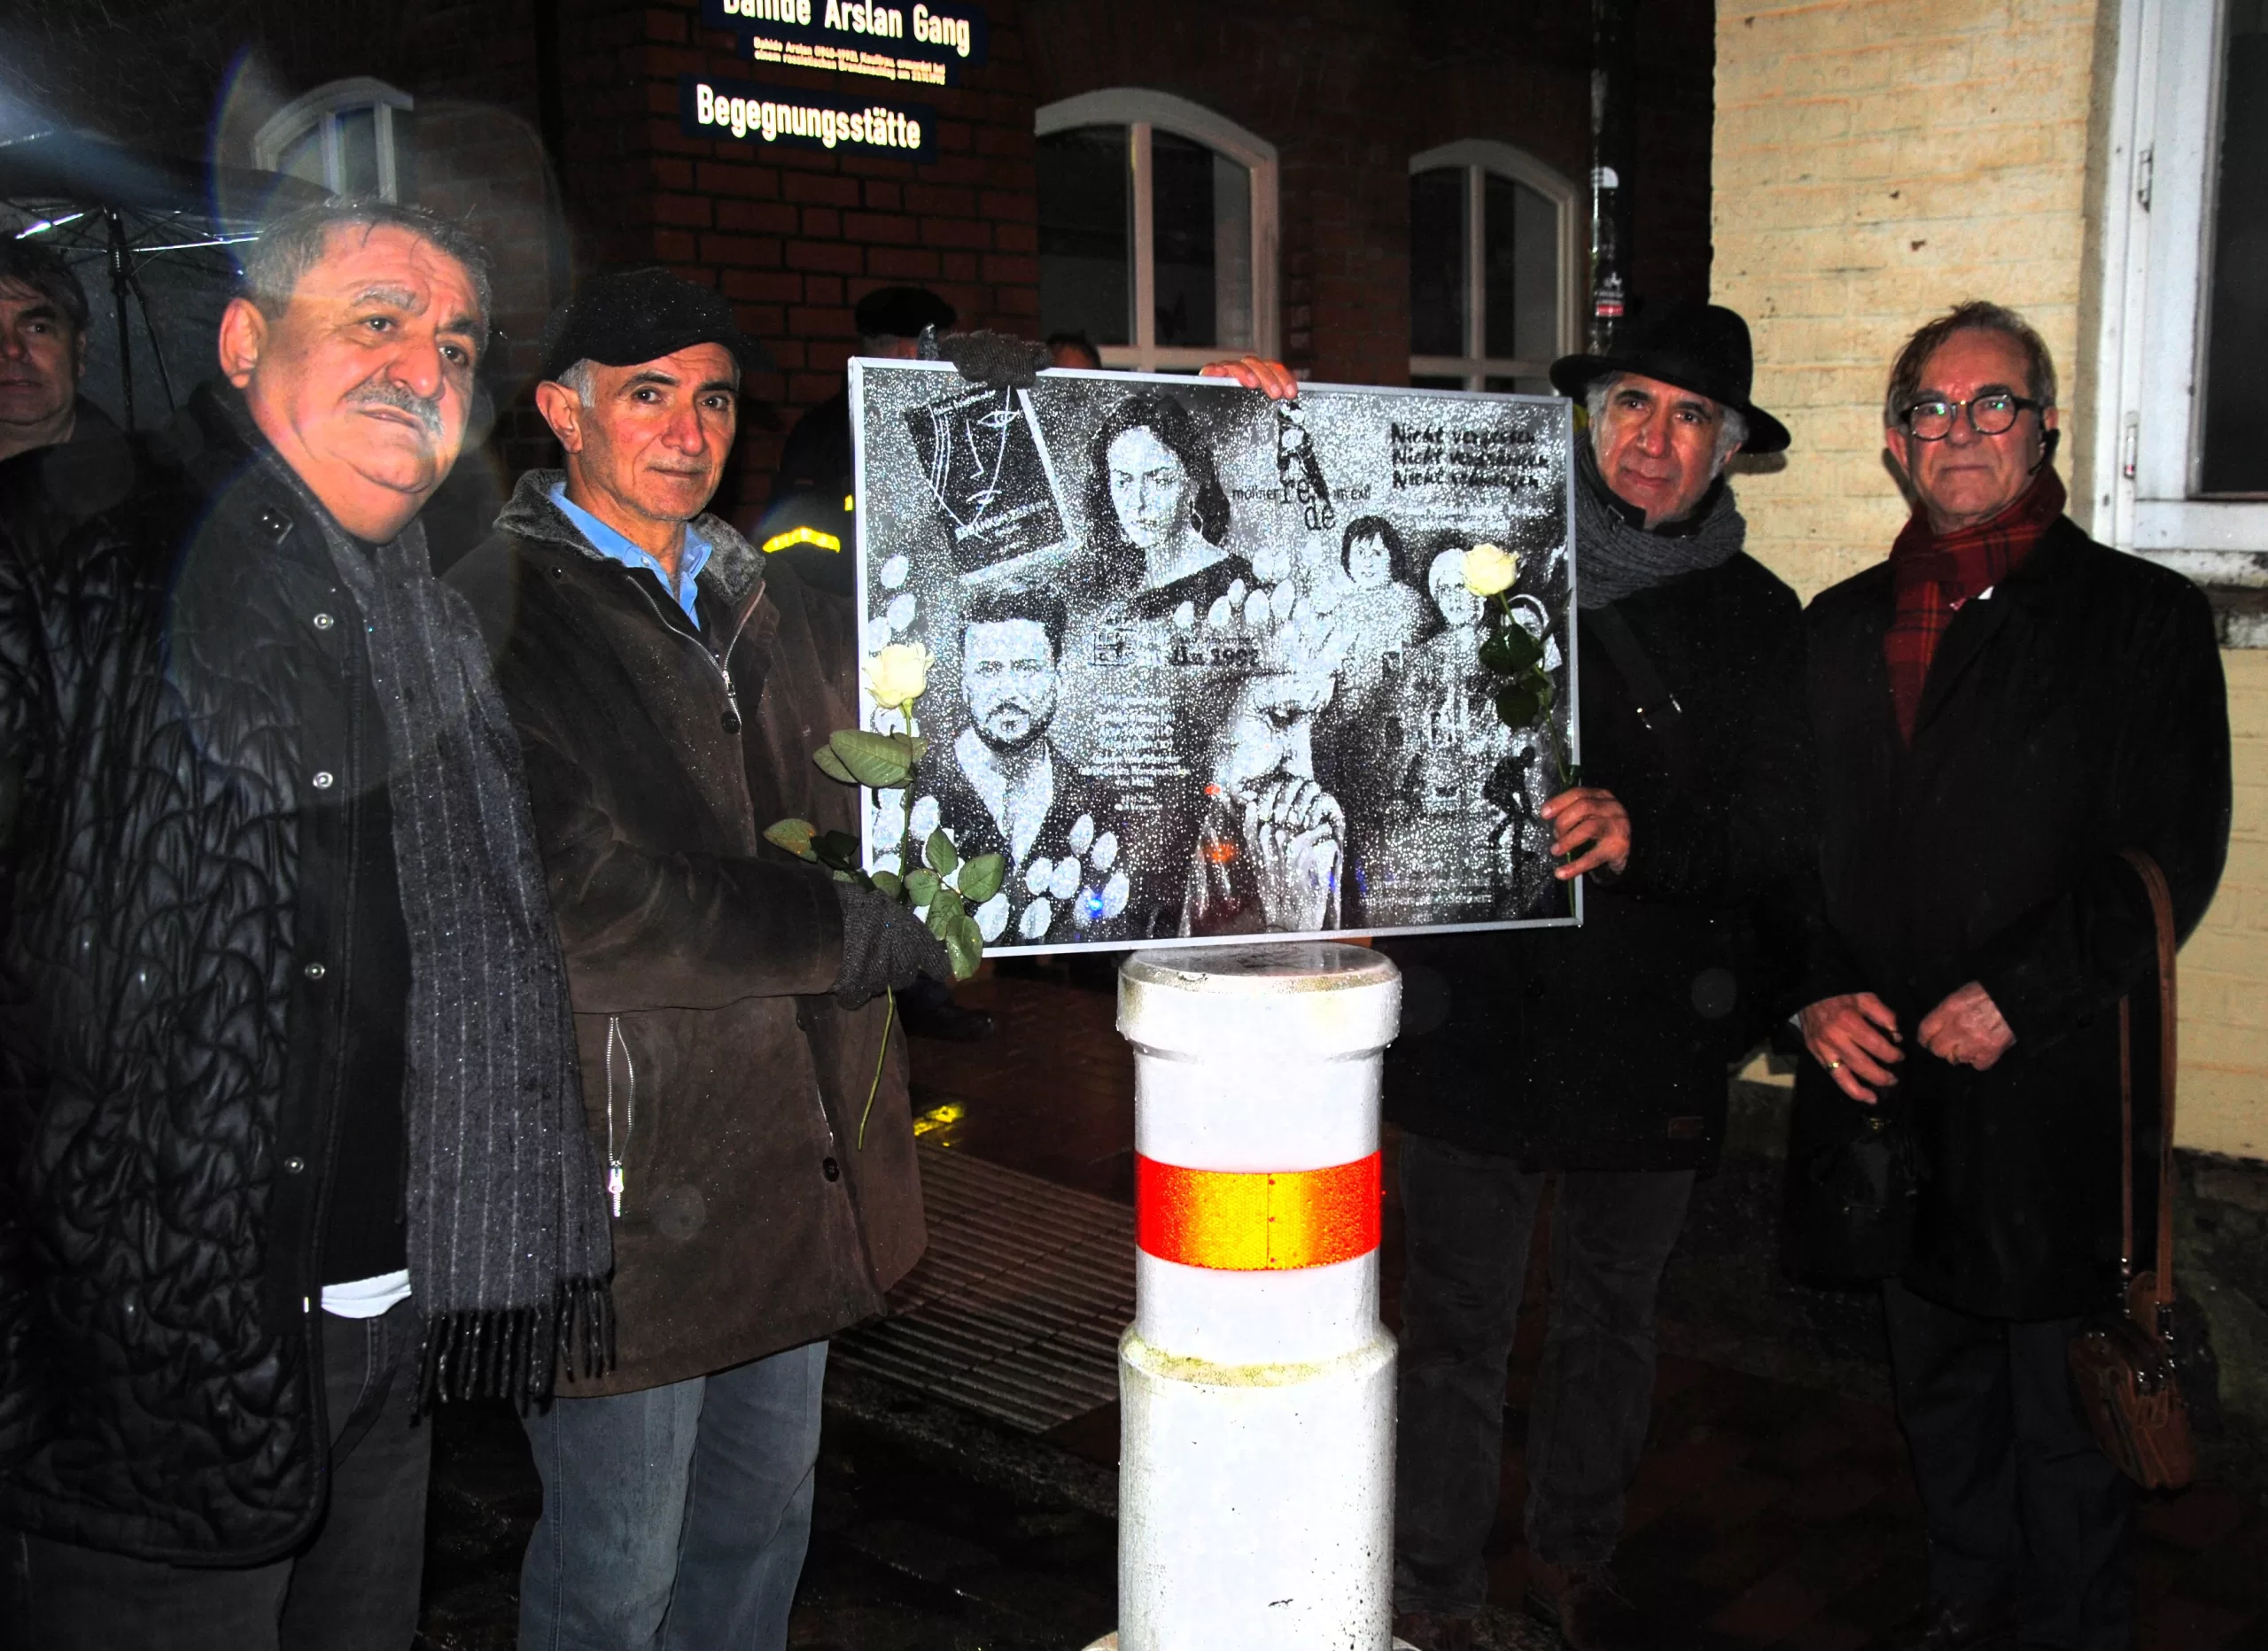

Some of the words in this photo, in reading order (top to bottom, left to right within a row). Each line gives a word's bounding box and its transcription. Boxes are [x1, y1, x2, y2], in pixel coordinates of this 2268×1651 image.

[824, 0, 903, 39] Arslan
[913, 4, 970, 58] Gang
[696, 83, 921, 150] Begegnungsstätte
[1391, 422, 1444, 444] Nicht
[1392, 446, 1444, 467] Nicht
[1392, 467, 1444, 490] Nicht
[1304, 496, 1336, 531] de
